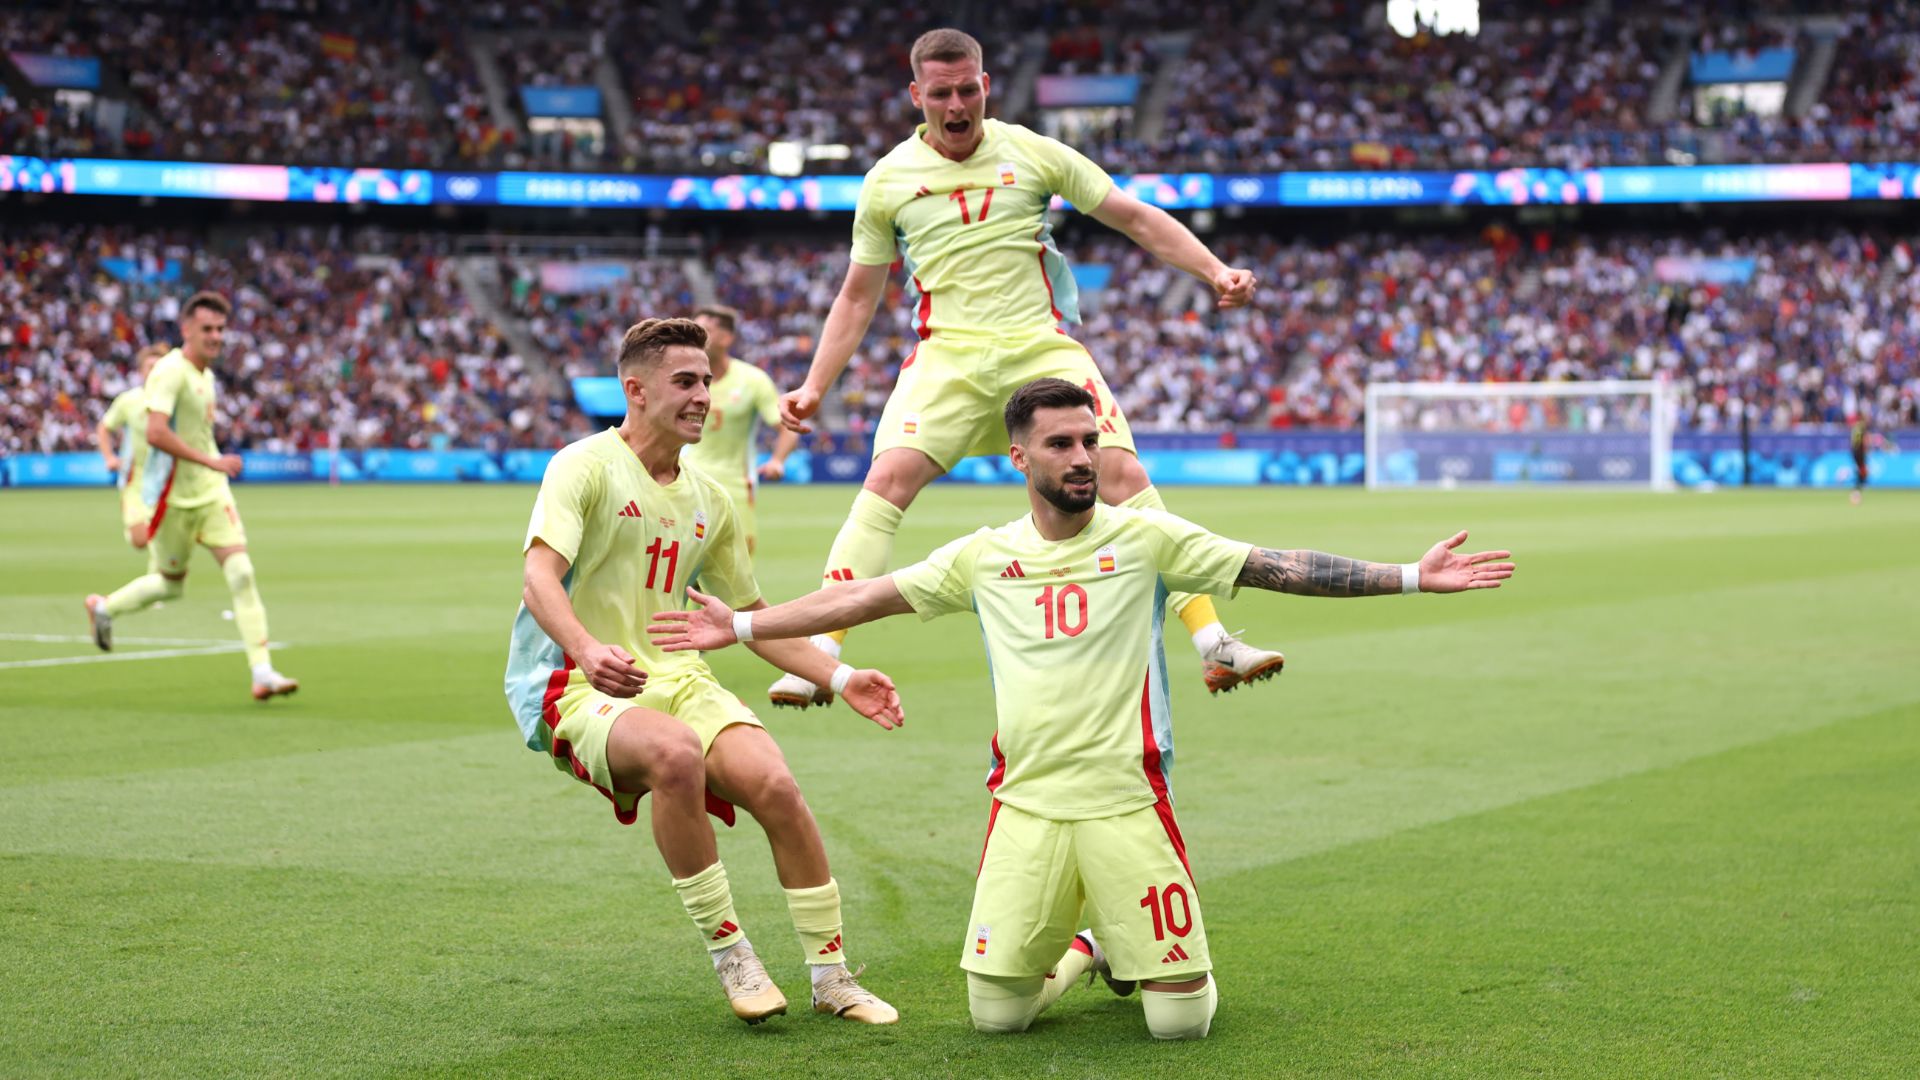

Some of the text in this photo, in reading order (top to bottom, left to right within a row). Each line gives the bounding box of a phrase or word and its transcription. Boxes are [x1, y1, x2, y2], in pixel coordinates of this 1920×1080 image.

[949, 187, 995, 225] 17
[645, 537, 680, 593] 11
[1035, 583, 1089, 639] 10
[1140, 882, 1194, 942] 10
